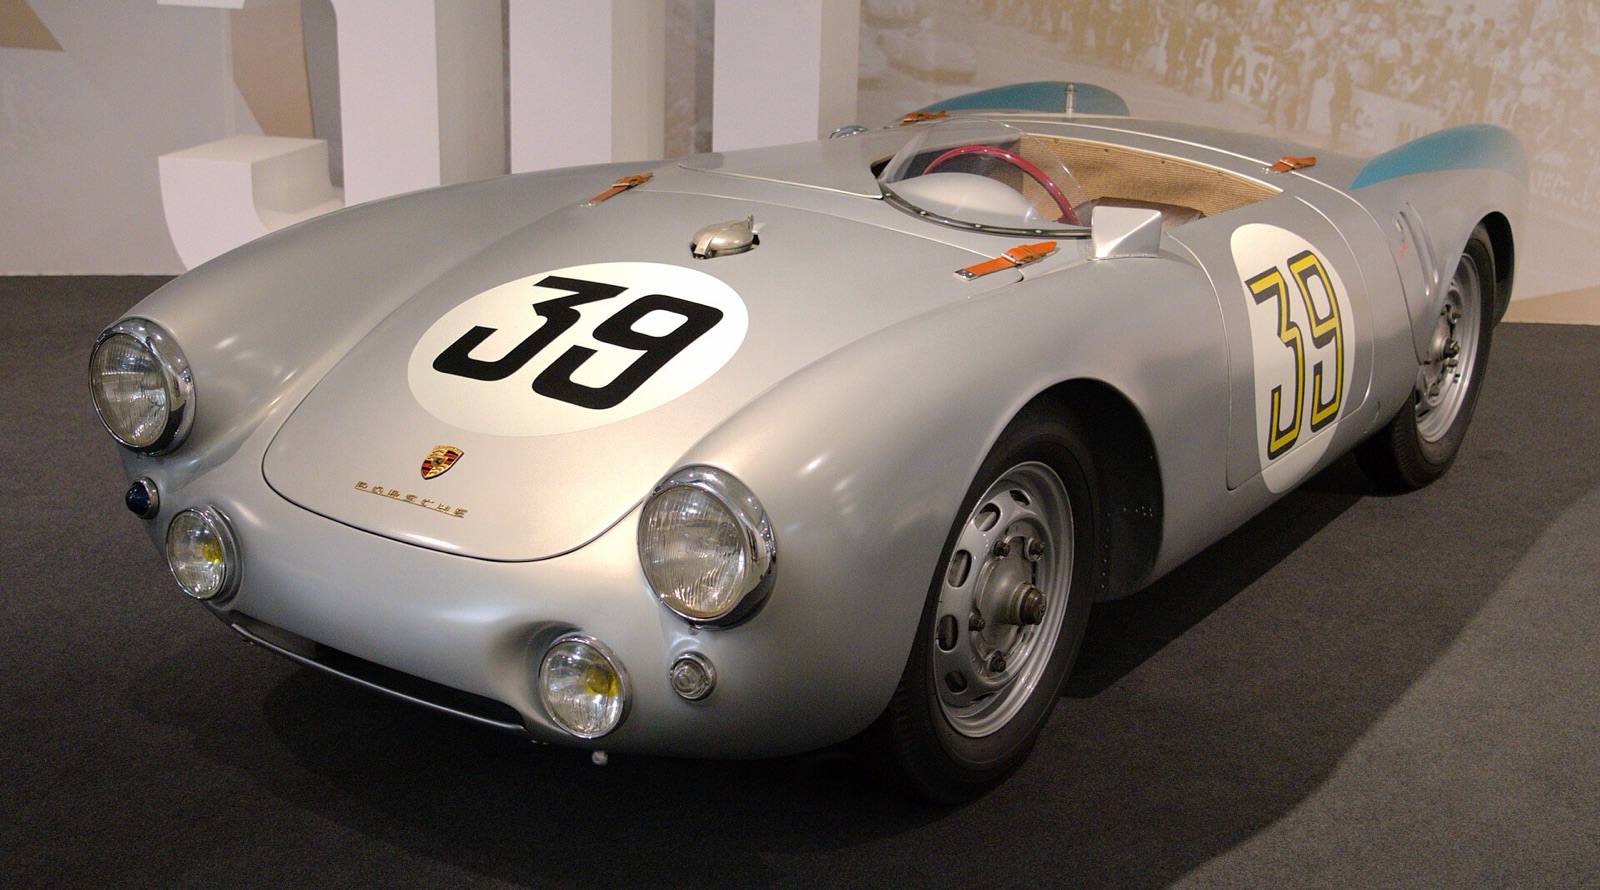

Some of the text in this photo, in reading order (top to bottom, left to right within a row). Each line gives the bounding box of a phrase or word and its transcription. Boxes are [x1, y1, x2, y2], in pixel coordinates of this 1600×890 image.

[432, 275, 725, 411] 39
[1244, 250, 1345, 461] 39
[354, 480, 468, 519] PORSCHE
